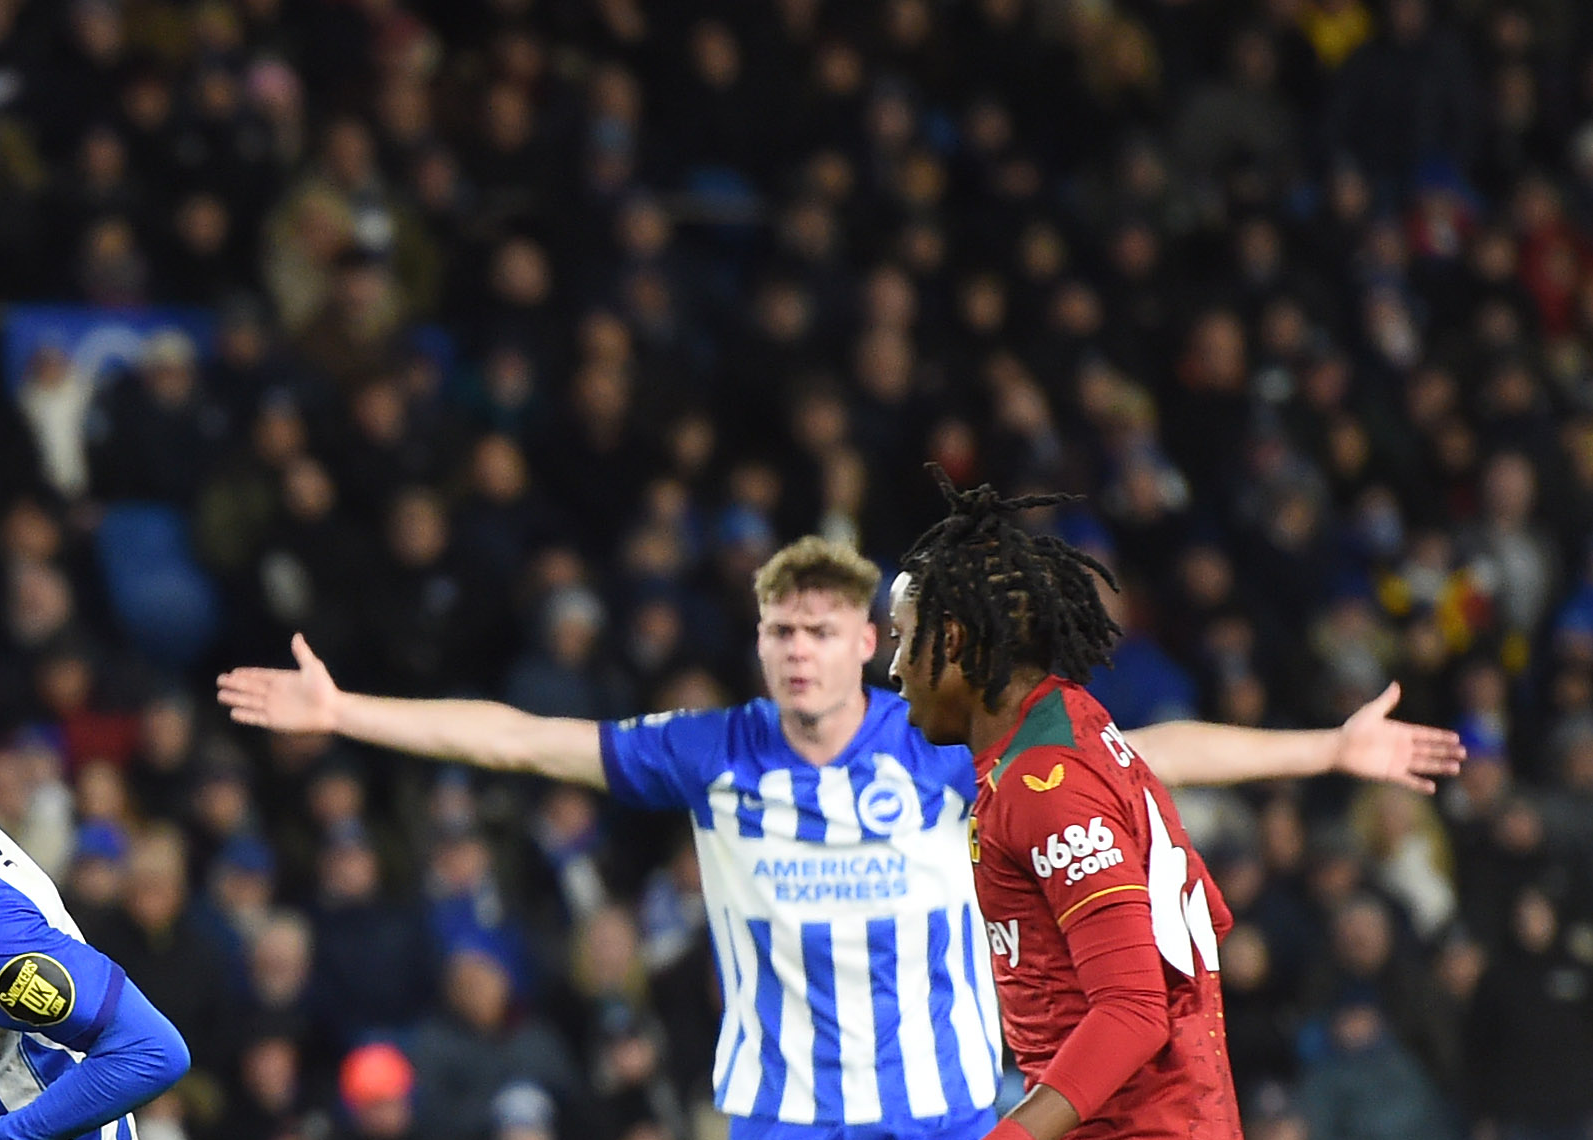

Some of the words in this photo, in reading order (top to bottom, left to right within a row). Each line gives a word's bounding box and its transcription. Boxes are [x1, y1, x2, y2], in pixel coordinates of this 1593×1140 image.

[1031, 816, 1115, 879] 6686
[753, 855, 906, 877] AMERICAN
[1065, 847, 1124, 886] .com
[775, 879, 907, 901] EXPRESS
[24, 981, 53, 1010] UK
